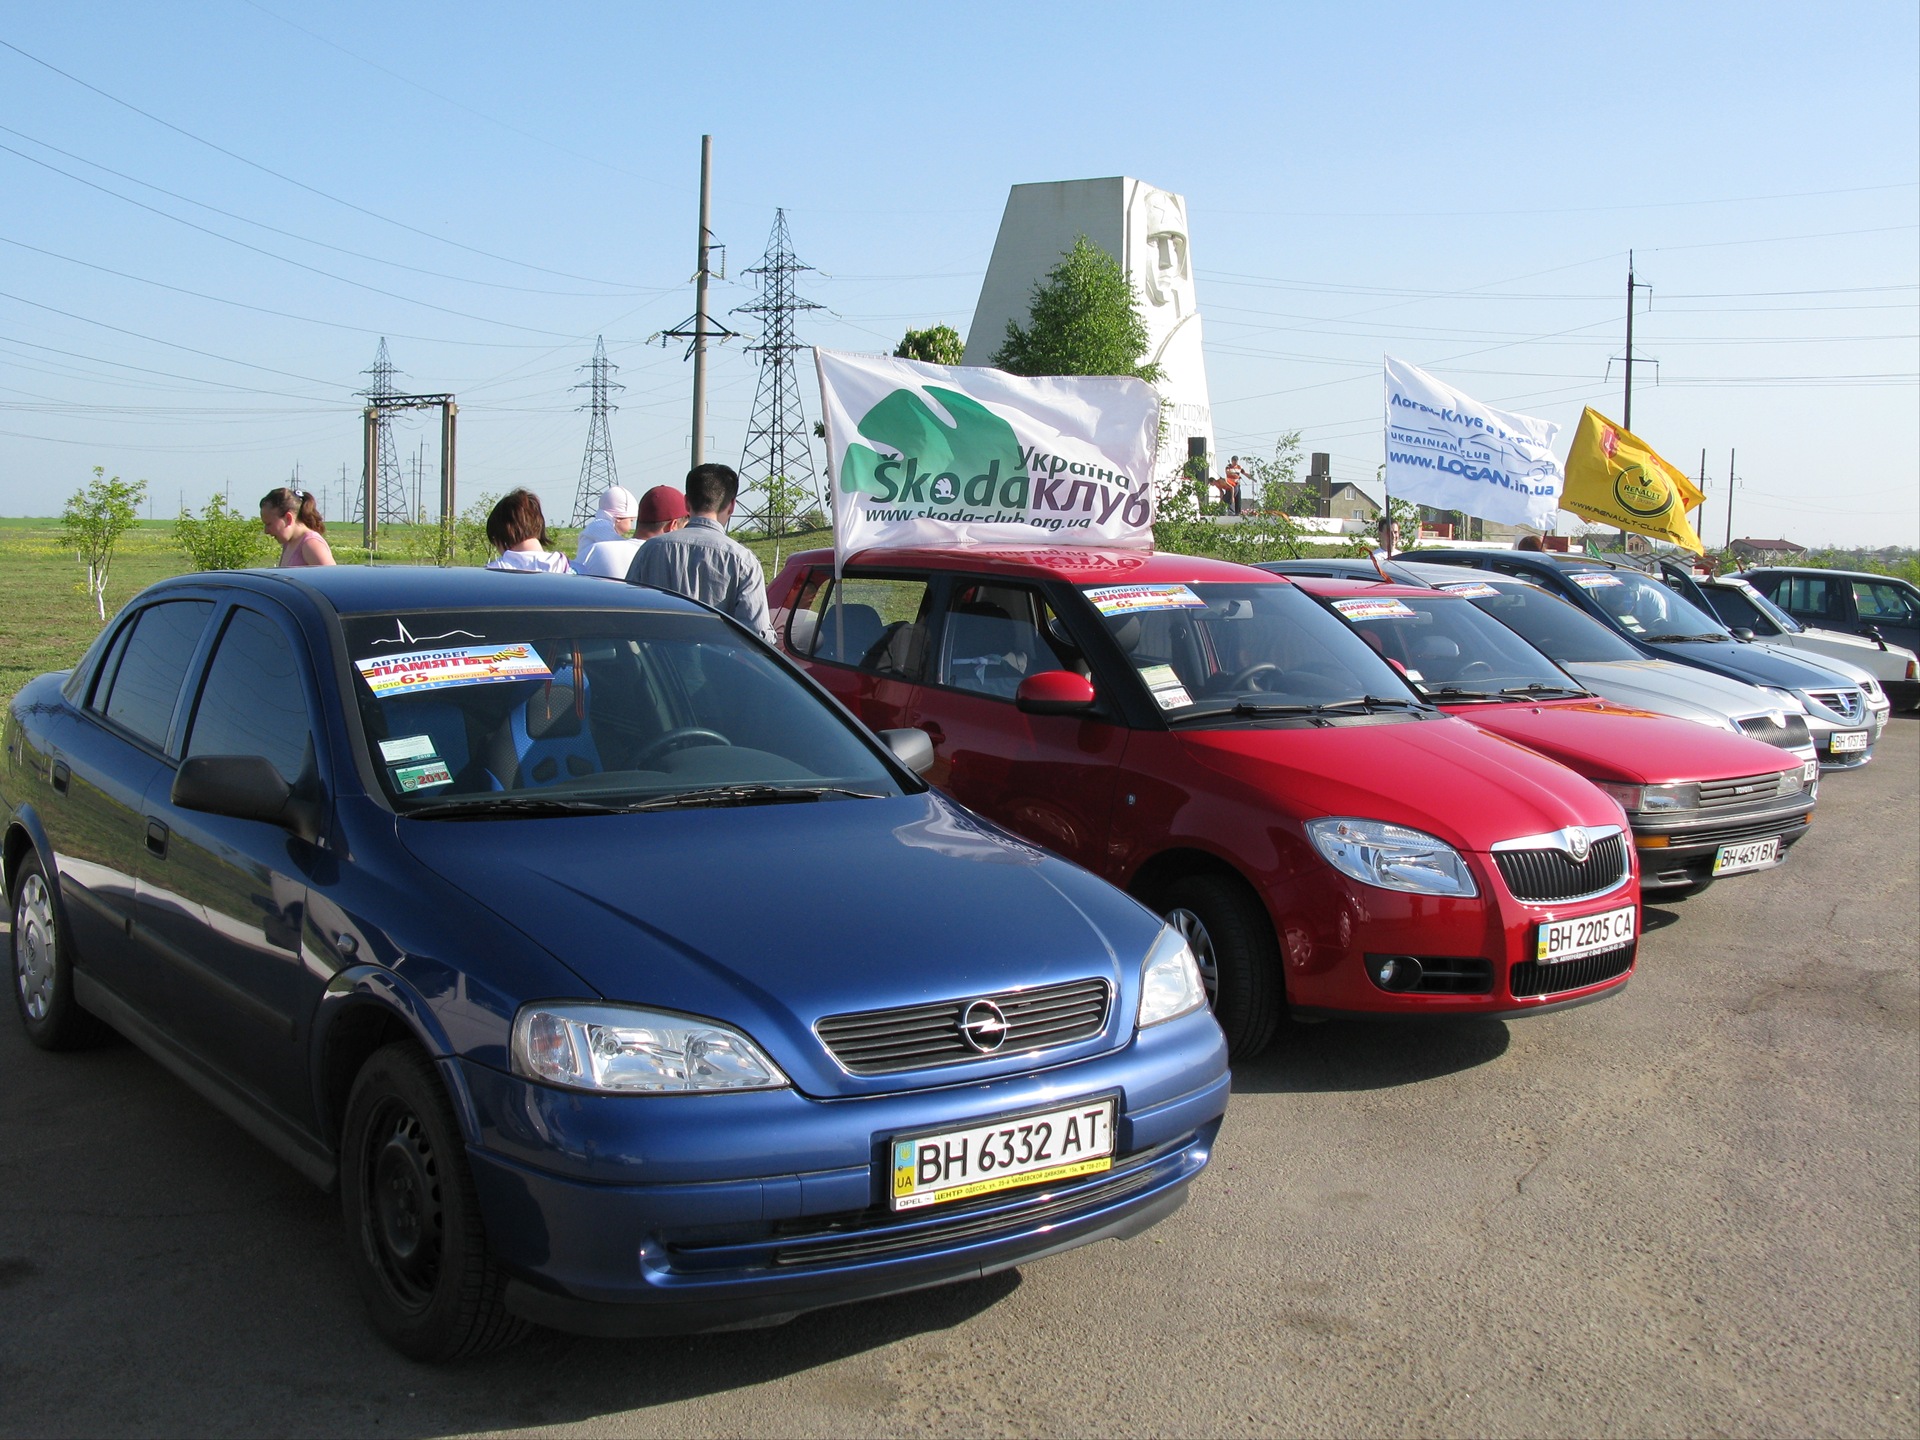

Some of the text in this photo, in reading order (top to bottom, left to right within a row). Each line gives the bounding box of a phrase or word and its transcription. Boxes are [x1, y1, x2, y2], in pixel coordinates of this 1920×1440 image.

[1391, 431, 1457, 451] UKRAINIAN
[1014, 446, 1130, 490] Україна
[1390, 451, 1554, 496] www.LOGAN.in.ua
[1623, 484, 1661, 500] RENAULT
[1115, 600, 1133, 608] 65
[371, 650, 468, 668] АВТОПРОБЕГ
[373, 657, 481, 677] ПАМЯТЬ
[376, 681, 400, 690] 2010
[400, 672, 429, 684] 65
[417, 771, 450, 785] 2012
[1721, 848, 1738, 867] BH
[1761, 842, 1776, 861] BX
[1549, 925, 1572, 953] BH
[1576, 917, 1610, 947] 2205
[1614, 912, 1631, 937] CA
[917, 1109, 1104, 1185] BH 6332 AT
[897, 1176, 912, 1188] UA
[900, 1198, 923, 1207] OPEL
[934, 1189, 963, 1201] ЦЕНТР
